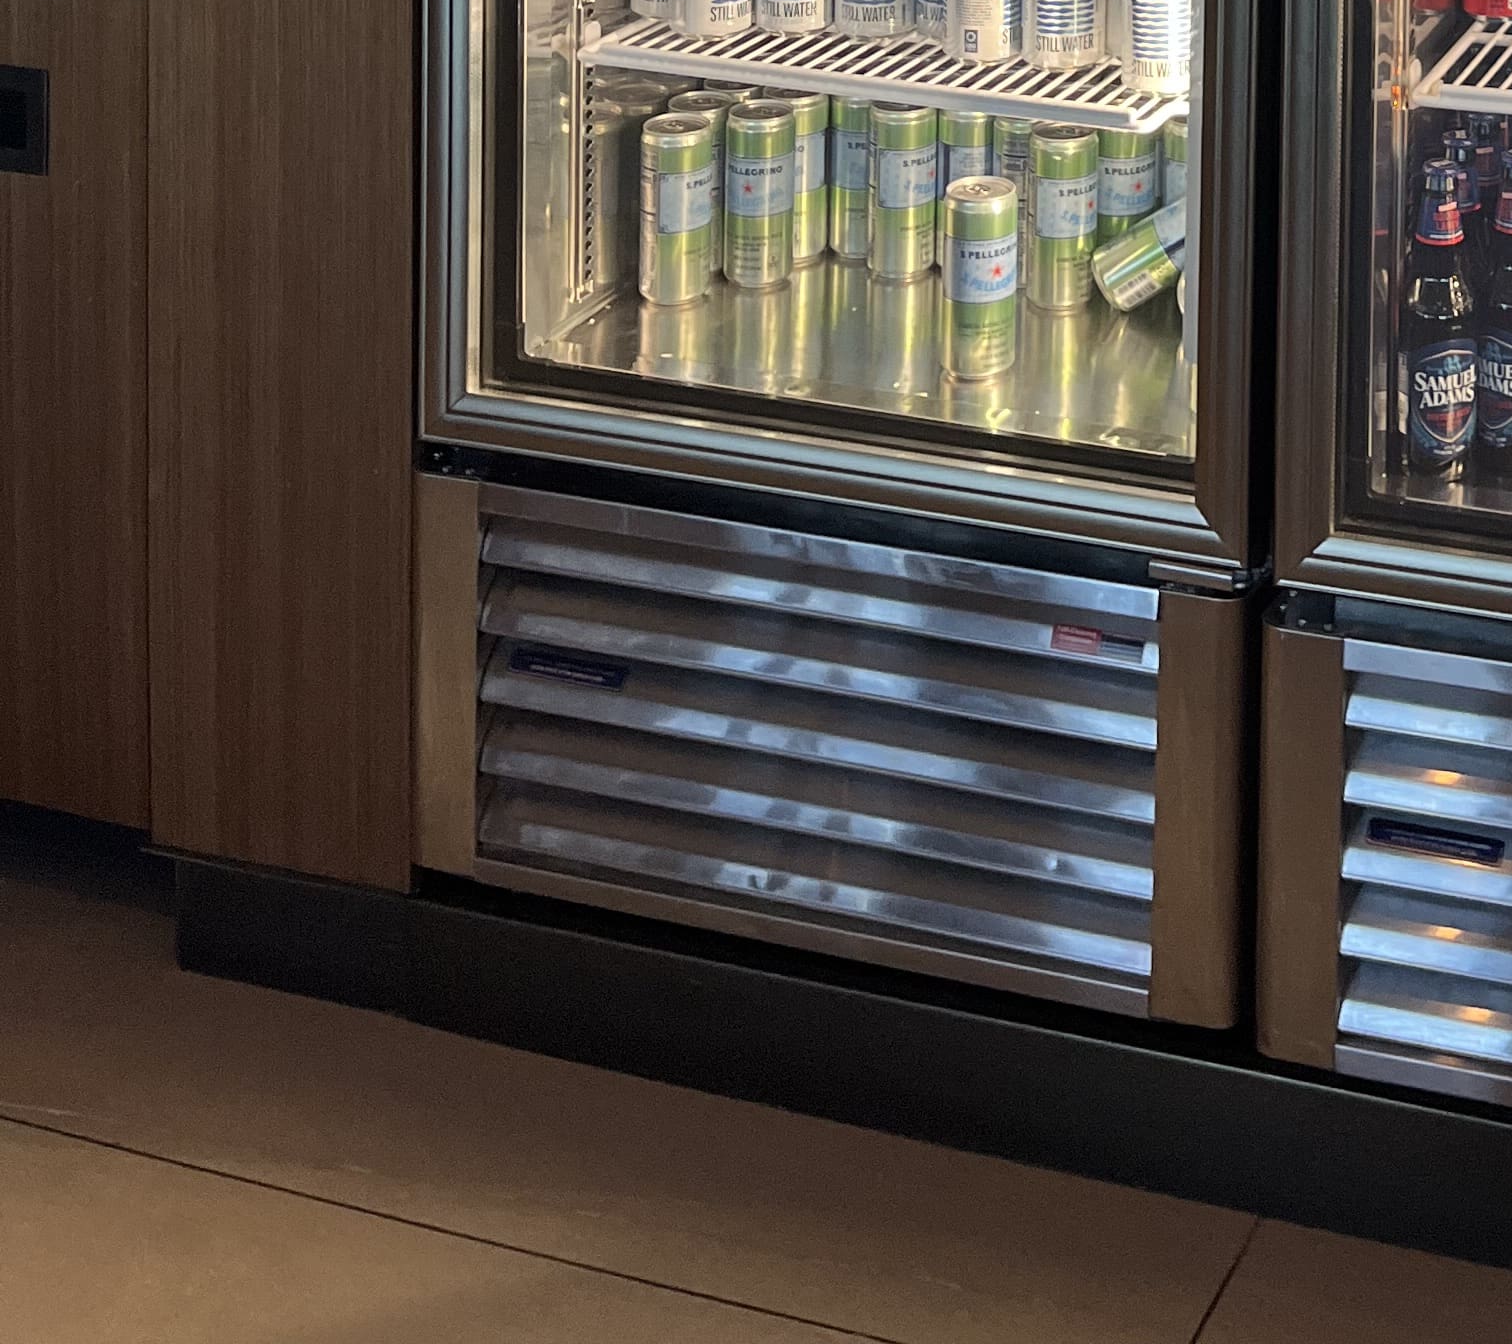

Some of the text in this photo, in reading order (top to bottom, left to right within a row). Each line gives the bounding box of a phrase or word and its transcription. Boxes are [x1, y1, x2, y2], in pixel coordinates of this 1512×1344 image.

[710, 5, 734, 22] STILL
[1036, 33, 1094, 53] STILL WATER
[1414, 364, 1476, 392] SAMUEL
[1419, 384, 1475, 409] ADAMS
